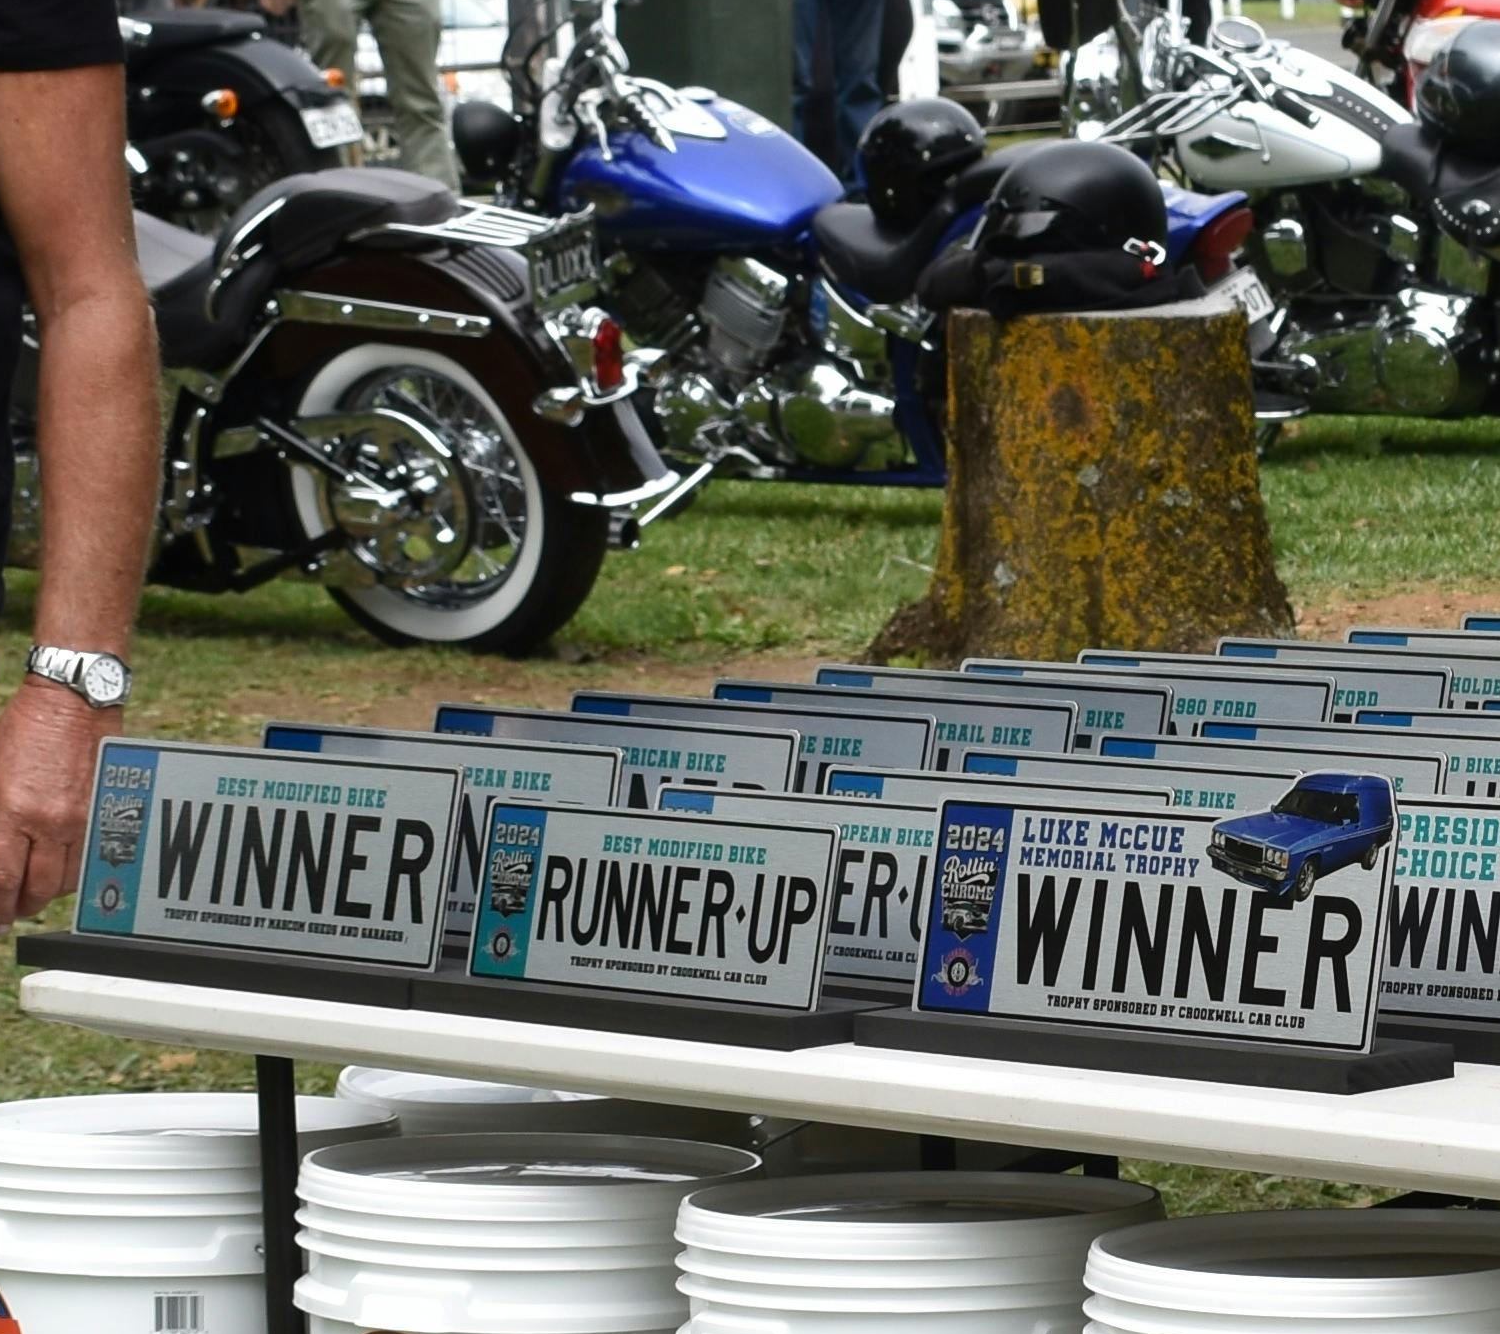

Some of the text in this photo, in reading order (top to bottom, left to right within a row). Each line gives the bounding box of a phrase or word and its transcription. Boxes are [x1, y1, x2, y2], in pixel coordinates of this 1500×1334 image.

[1213, 700, 1256, 718] FORD
[1336, 690, 1378, 706] FORD
[1085, 711, 1124, 729] BIKE
[937, 723, 1032, 746] TRAIL BIKE
[822, 737, 863, 757] BIKE
[687, 752, 726, 773] BIKE
[105, 765, 151, 790] 2024
[512, 771, 551, 791] BIKE
[217, 777, 387, 809] BEST MODIFIED BIKE
[1198, 791, 1236, 809] BIKE
[495, 822, 540, 846] 2024
[896, 828, 933, 848] BIKE
[946, 825, 1004, 853] 2024
[1022, 817, 1090, 847] LUKE
[158, 799, 434, 924] WINNER
[603, 835, 767, 865] BEST MODIFIED BIKE
[1019, 847, 1199, 878] MEMORIAL TROPHY
[1395, 849, 1497, 881] CHOICE
[942, 883, 995, 901] CHROME
[165, 908, 199, 922] TROPHY
[201, 912, 251, 927] SPONSORED
[254, 917, 265, 928] BY
[340, 925, 359, 938] AND
[834, 946, 907, 963] CROOKWELL CAR
[1017, 873, 1362, 1013] WINNER
[570, 956, 767, 985] TROPHY SPONSORED BY CROOKWELL CAR CLUB
[1380, 981, 1422, 995] TROPHY
[1426, 985, 1493, 1001] SPONSORED
[1047, 995, 1305, 1029] TROPHY SPONSORED BY CROOKWELL CAR CLUB
